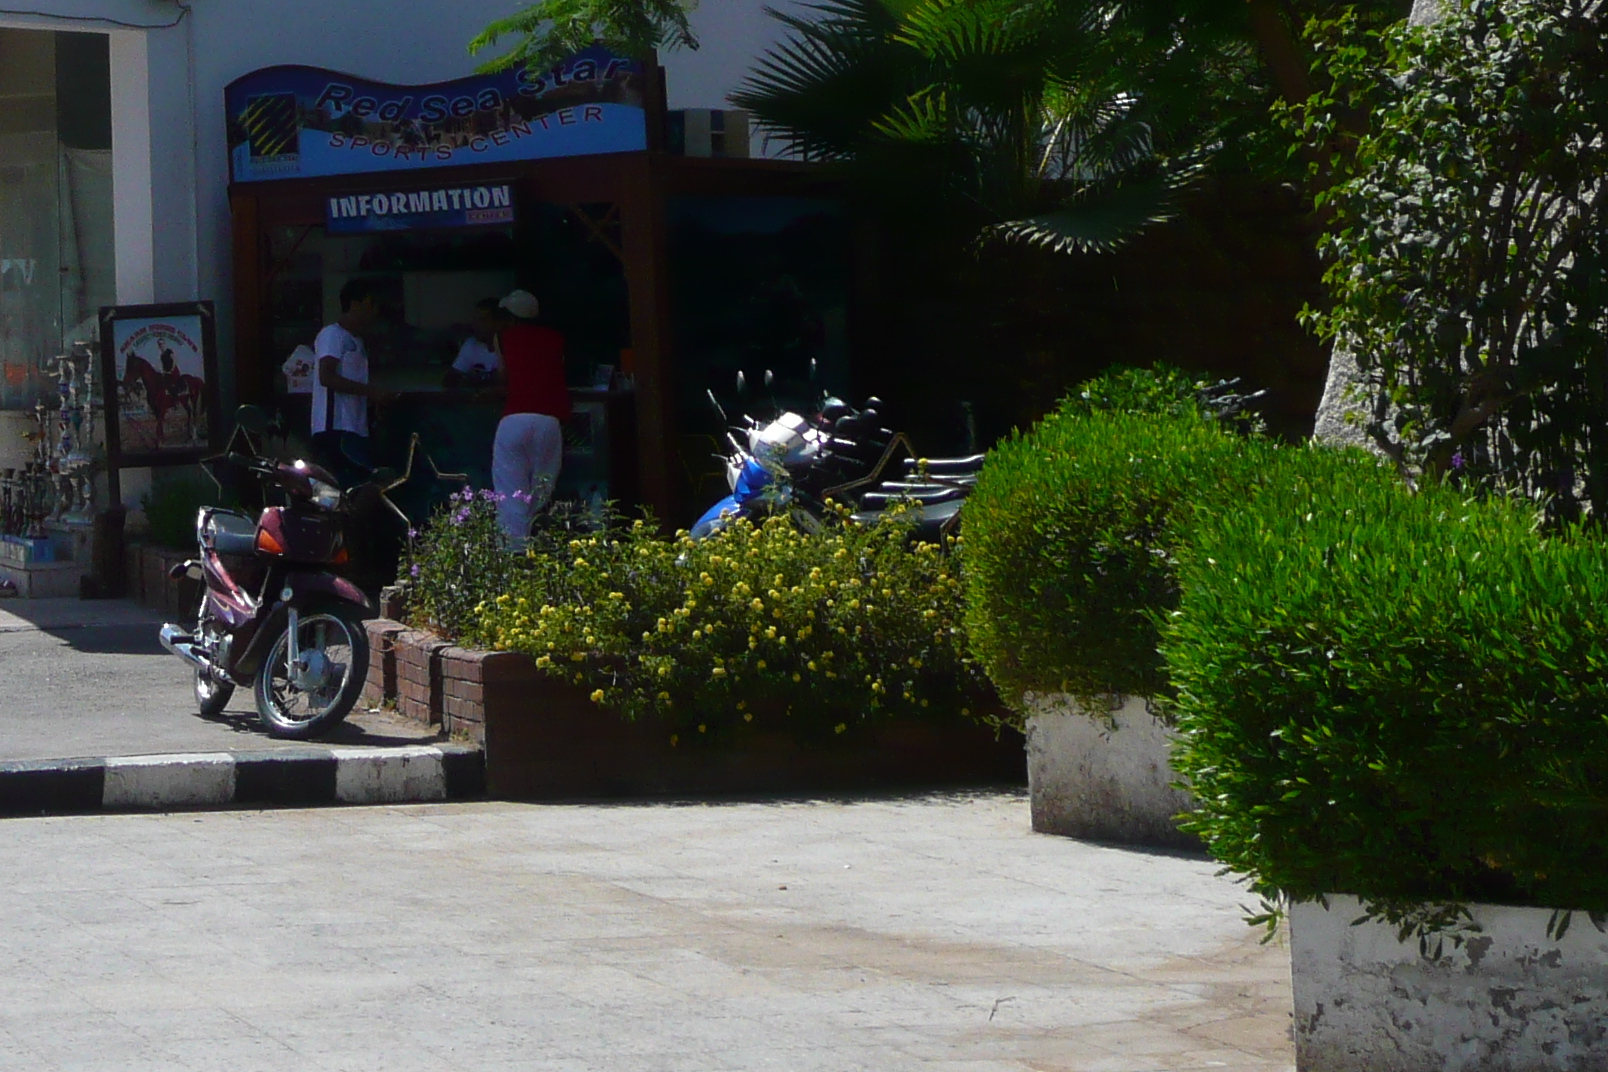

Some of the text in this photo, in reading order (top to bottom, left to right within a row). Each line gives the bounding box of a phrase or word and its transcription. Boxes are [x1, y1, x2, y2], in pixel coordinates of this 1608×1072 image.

[315, 57, 631, 124] Red Sea Star
[329, 105, 604, 161] SPORTS CENTER
[330, 184, 511, 219] INFORMATION
